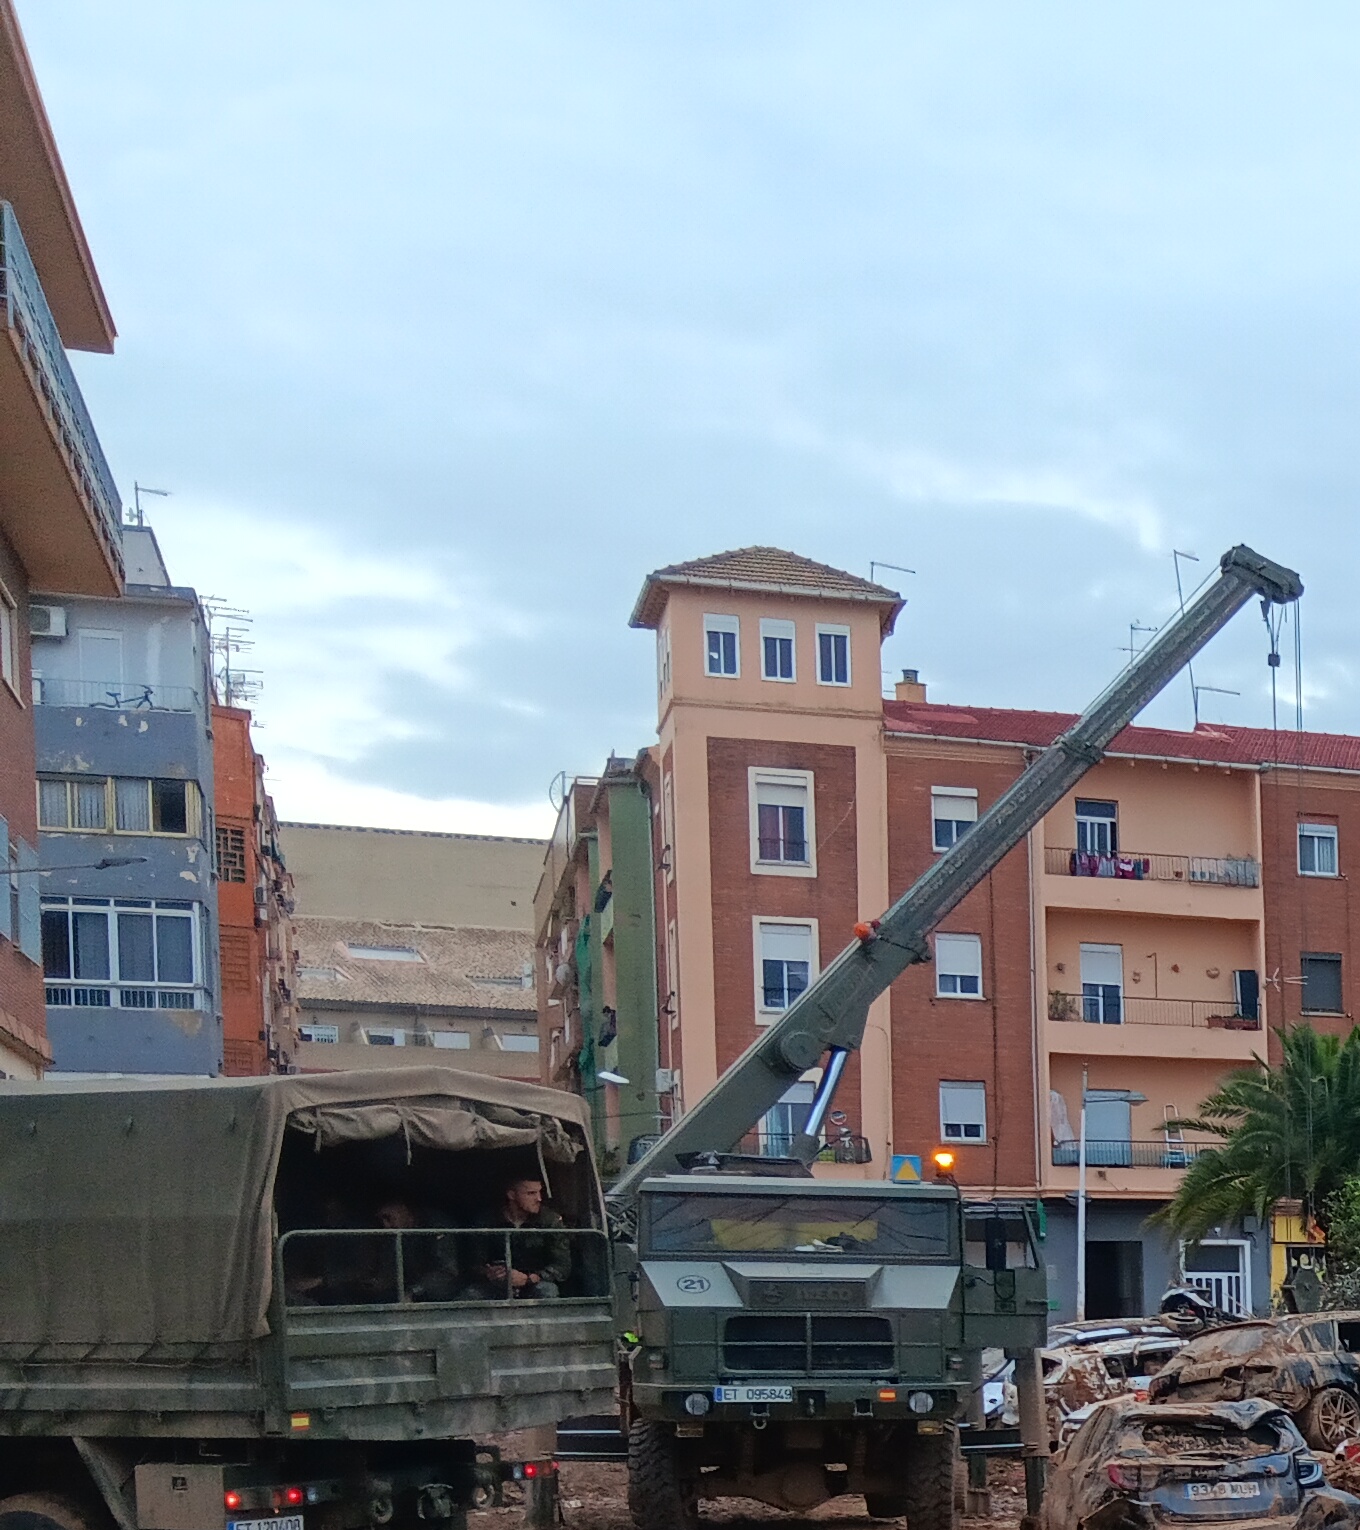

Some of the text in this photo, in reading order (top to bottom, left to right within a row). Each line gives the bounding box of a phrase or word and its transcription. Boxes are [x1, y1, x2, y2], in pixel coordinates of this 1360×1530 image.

[683, 1279, 705, 1290] 21
[724, 1388, 792, 1401] ET 095849
